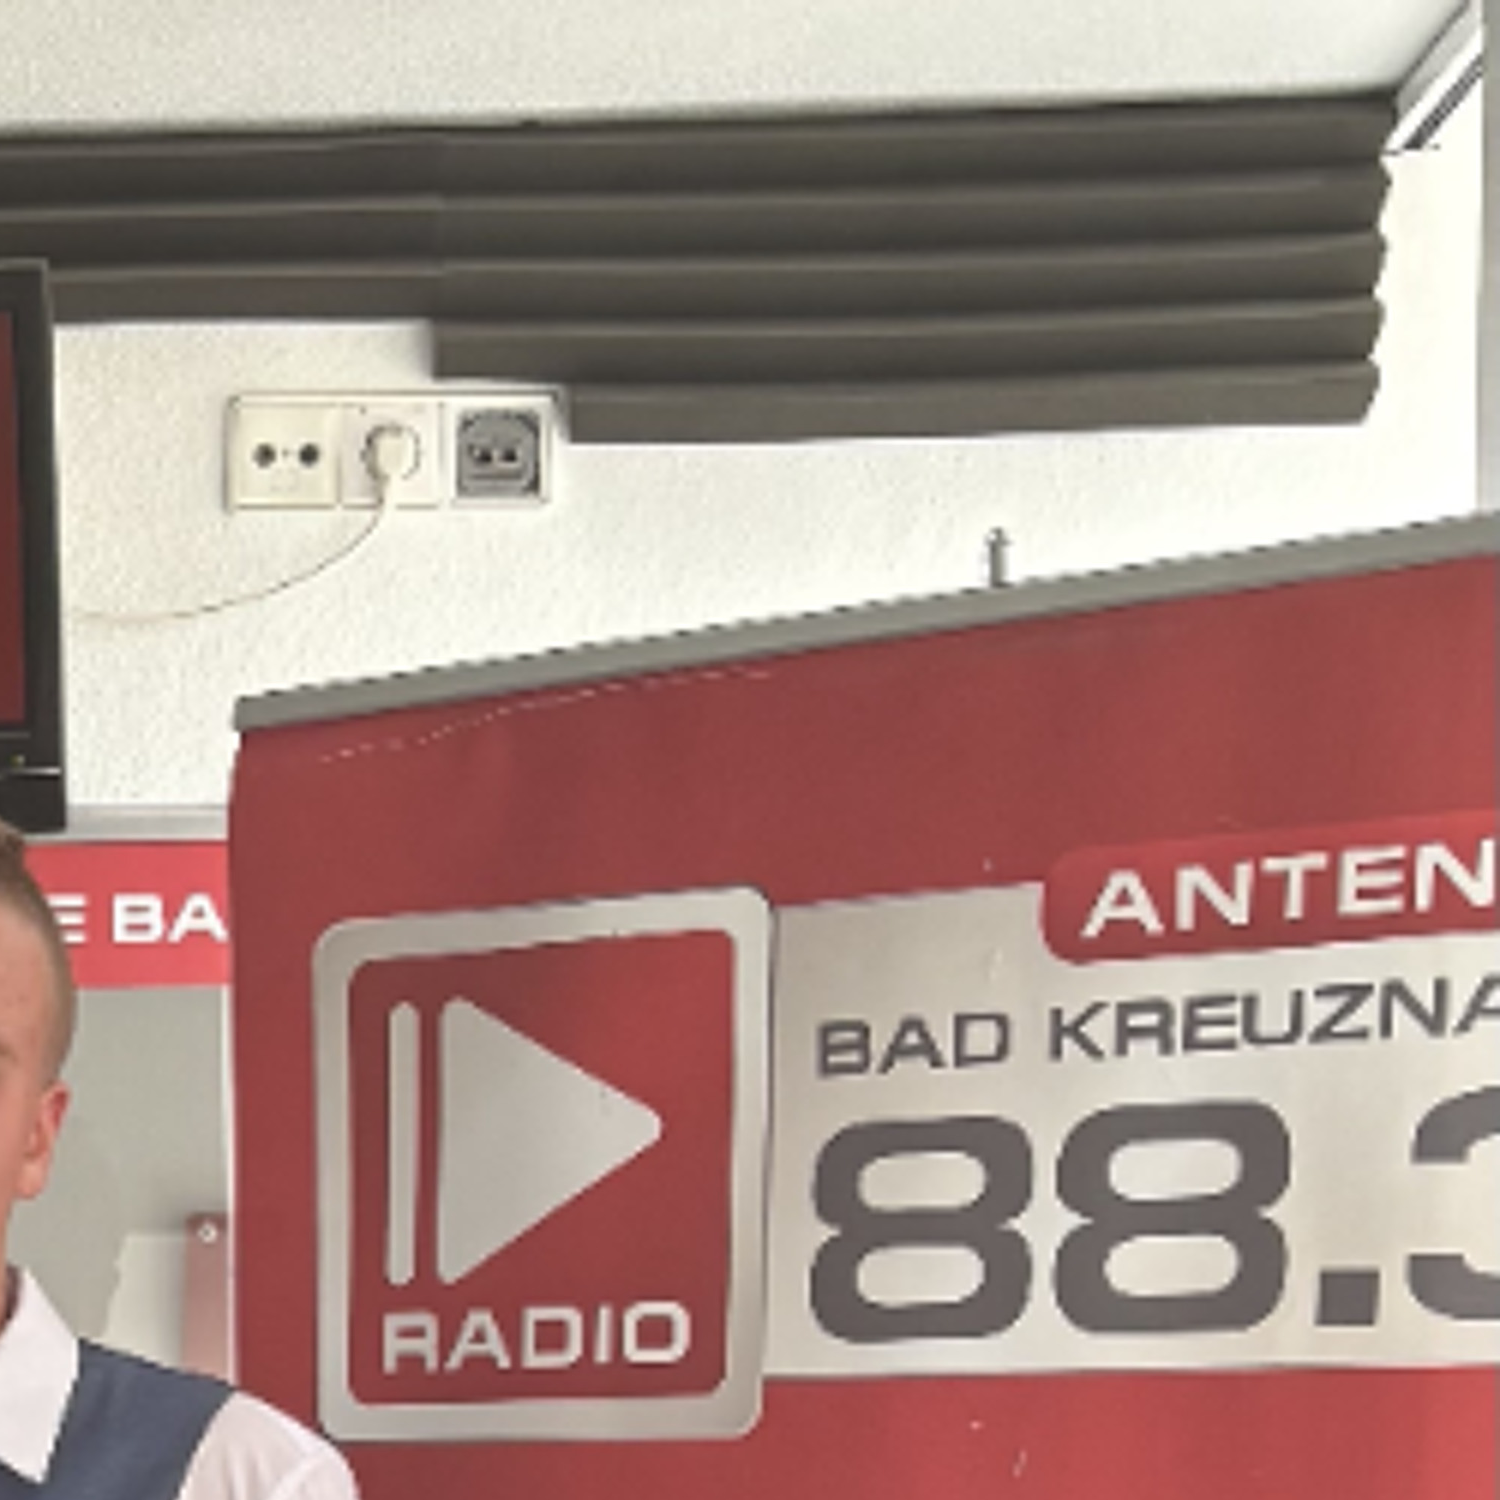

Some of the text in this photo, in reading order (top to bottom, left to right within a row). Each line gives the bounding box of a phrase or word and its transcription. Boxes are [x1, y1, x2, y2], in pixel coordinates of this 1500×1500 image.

[1080, 838, 1498, 939] ANTEN
[818, 1008, 1011, 1079] BAD
[382, 1299, 694, 1376] RADIO
